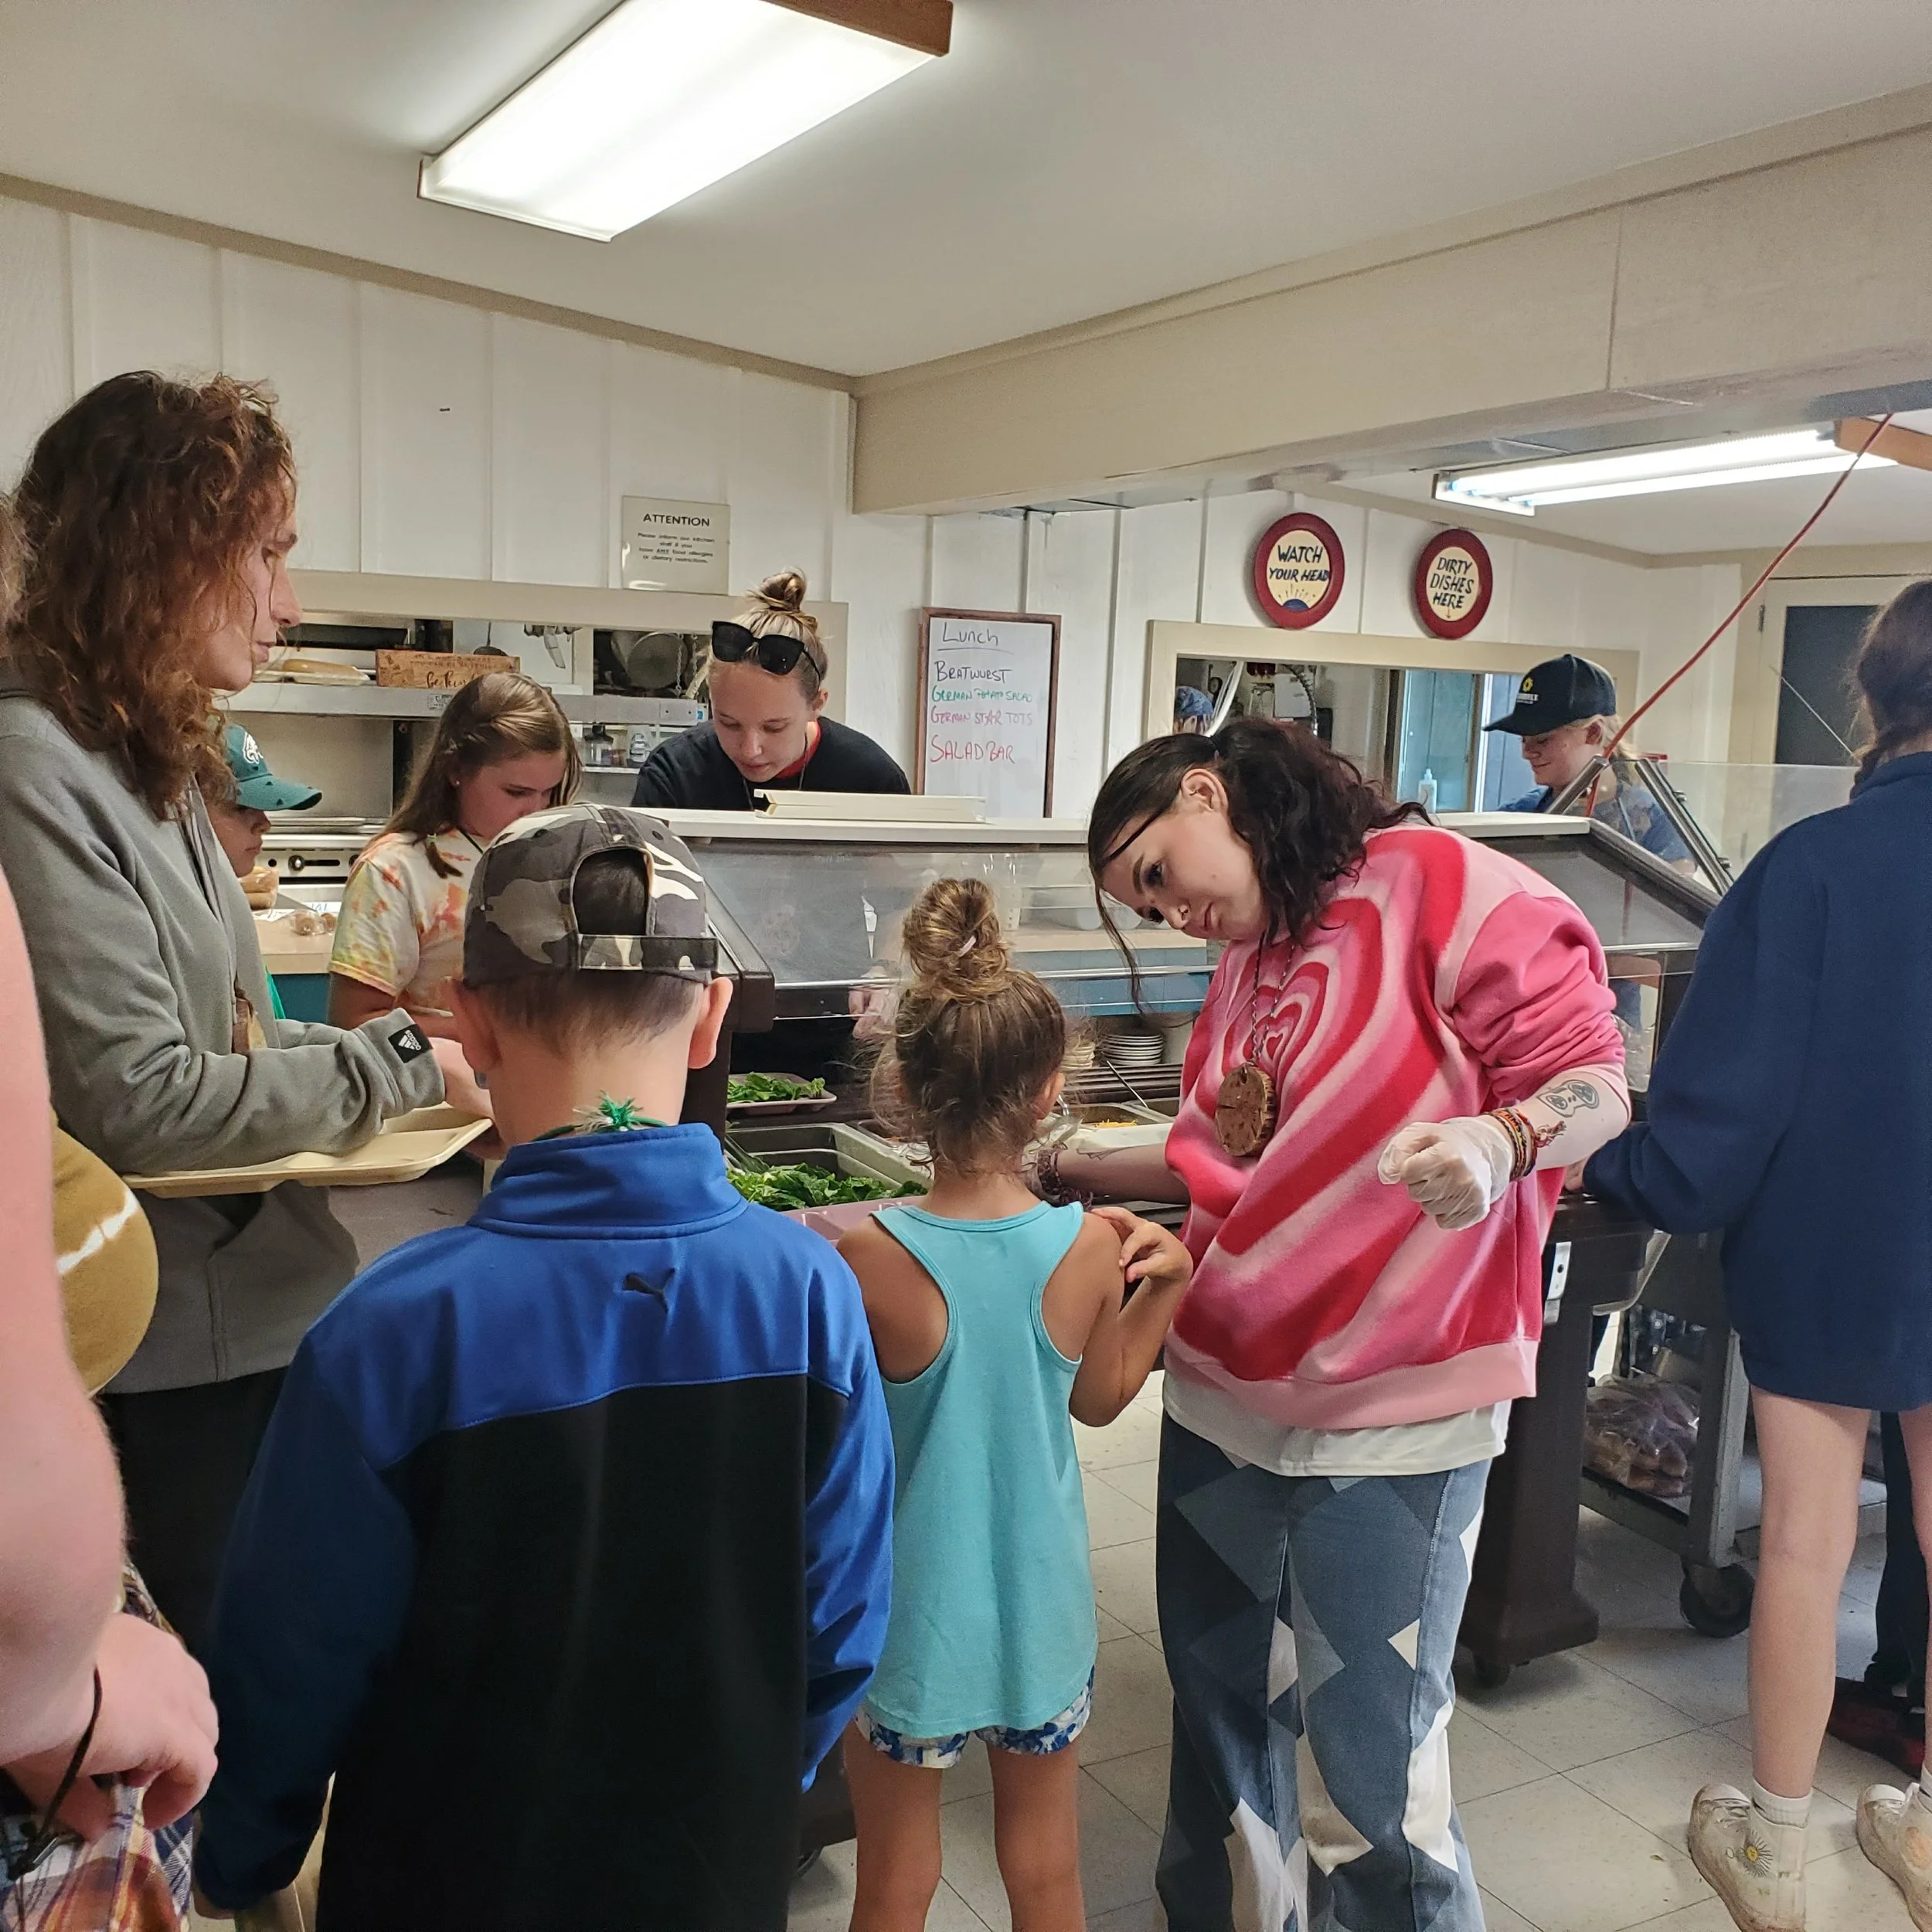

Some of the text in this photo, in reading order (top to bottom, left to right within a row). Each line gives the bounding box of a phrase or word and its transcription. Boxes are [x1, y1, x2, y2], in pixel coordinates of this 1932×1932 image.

[643, 513, 709, 526] ATTENTION
[1277, 545, 1324, 563] WATCH
[1269, 566, 1329, 582] YOUR HEAD
[1436, 557, 1473, 574] DIRTY
[1430, 573, 1475, 594] DISHES
[1433, 592, 1465, 609] HERE
[942, 621, 999, 646] Lunch
[930, 706, 970, 725] GERMAN
[1005, 712, 1033, 726] TOTS
[930, 734, 1015, 764] SALAD BAR
[404, 1029, 422, 1051] adidas
